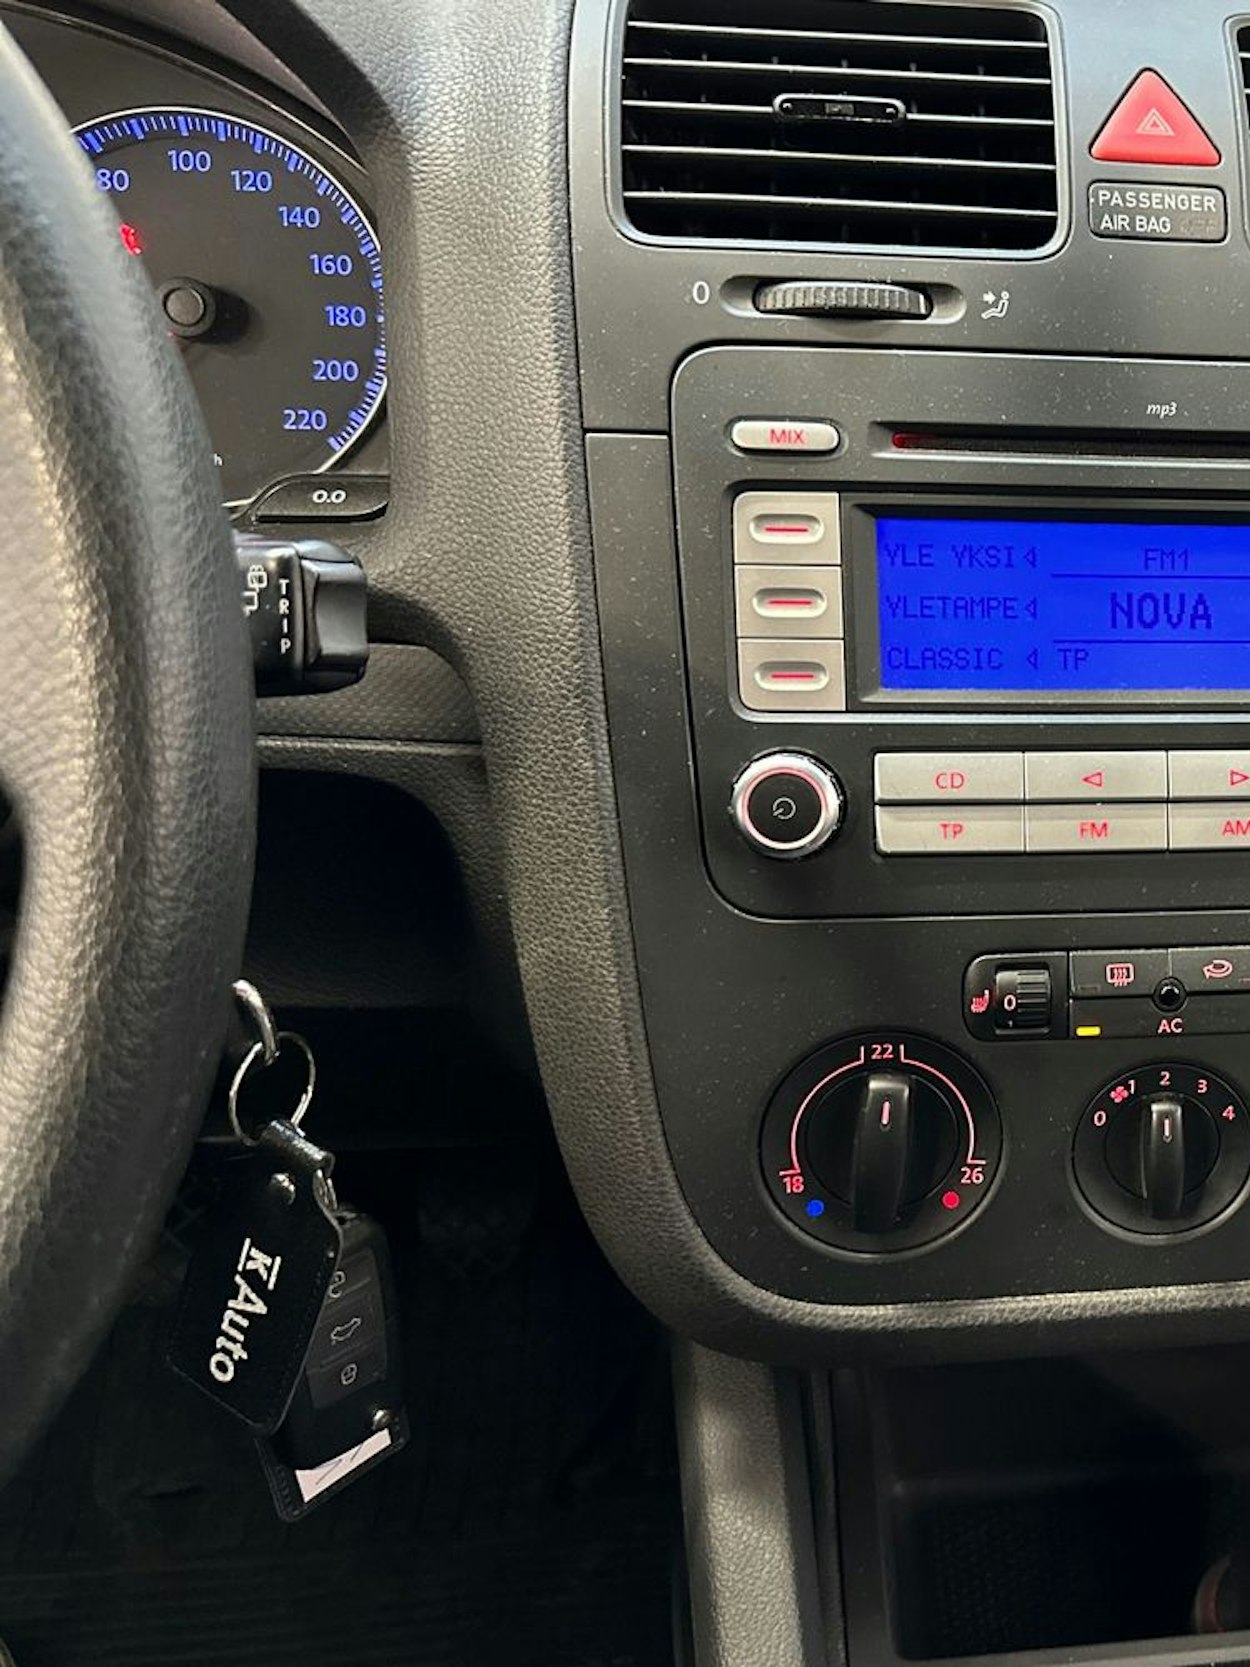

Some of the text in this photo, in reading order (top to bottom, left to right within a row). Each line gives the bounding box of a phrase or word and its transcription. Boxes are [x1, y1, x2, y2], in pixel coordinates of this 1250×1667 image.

[166, 150, 212, 172] 100
[97, 169, 130, 192] 80
[231, 170, 273, 192] 120
[1098, 189, 1217, 213] PASSENGER
[278, 206, 320, 228] 140
[1100, 214, 1131, 232] AIR
[1135, 215, 1171, 234] BAG
[309, 254, 353, 276] 160
[324, 305, 366, 328] 180
[312, 359, 358, 381] 200
[282, 409, 328, 431] 220
[1146, 401, 1177, 419] mp3
[769, 429, 805, 444] MIX
[884, 543, 1015, 568] YLE YKSI
[1144, 547, 1189, 572] FM1
[885, 595, 1019, 619] YLETAMPE
[1109, 592, 1213, 630] NOVA
[887, 647, 1004, 671] CLASSIC
[1057, 648, 1090, 671] TP
[935, 772, 965, 790] CD
[939, 823, 964, 840] TP
[1078, 822, 1109, 839] FM
[1158, 1018, 1183, 1033] AC
[871, 1044, 894, 1060] 22
[1159, 1071, 1170, 1086] 2
[1197, 1079, 1208, 1093] 3
[1222, 1105, 1235, 1121] 4
[782, 1176, 804, 1194] 18
[961, 1167, 984, 1184] 26
